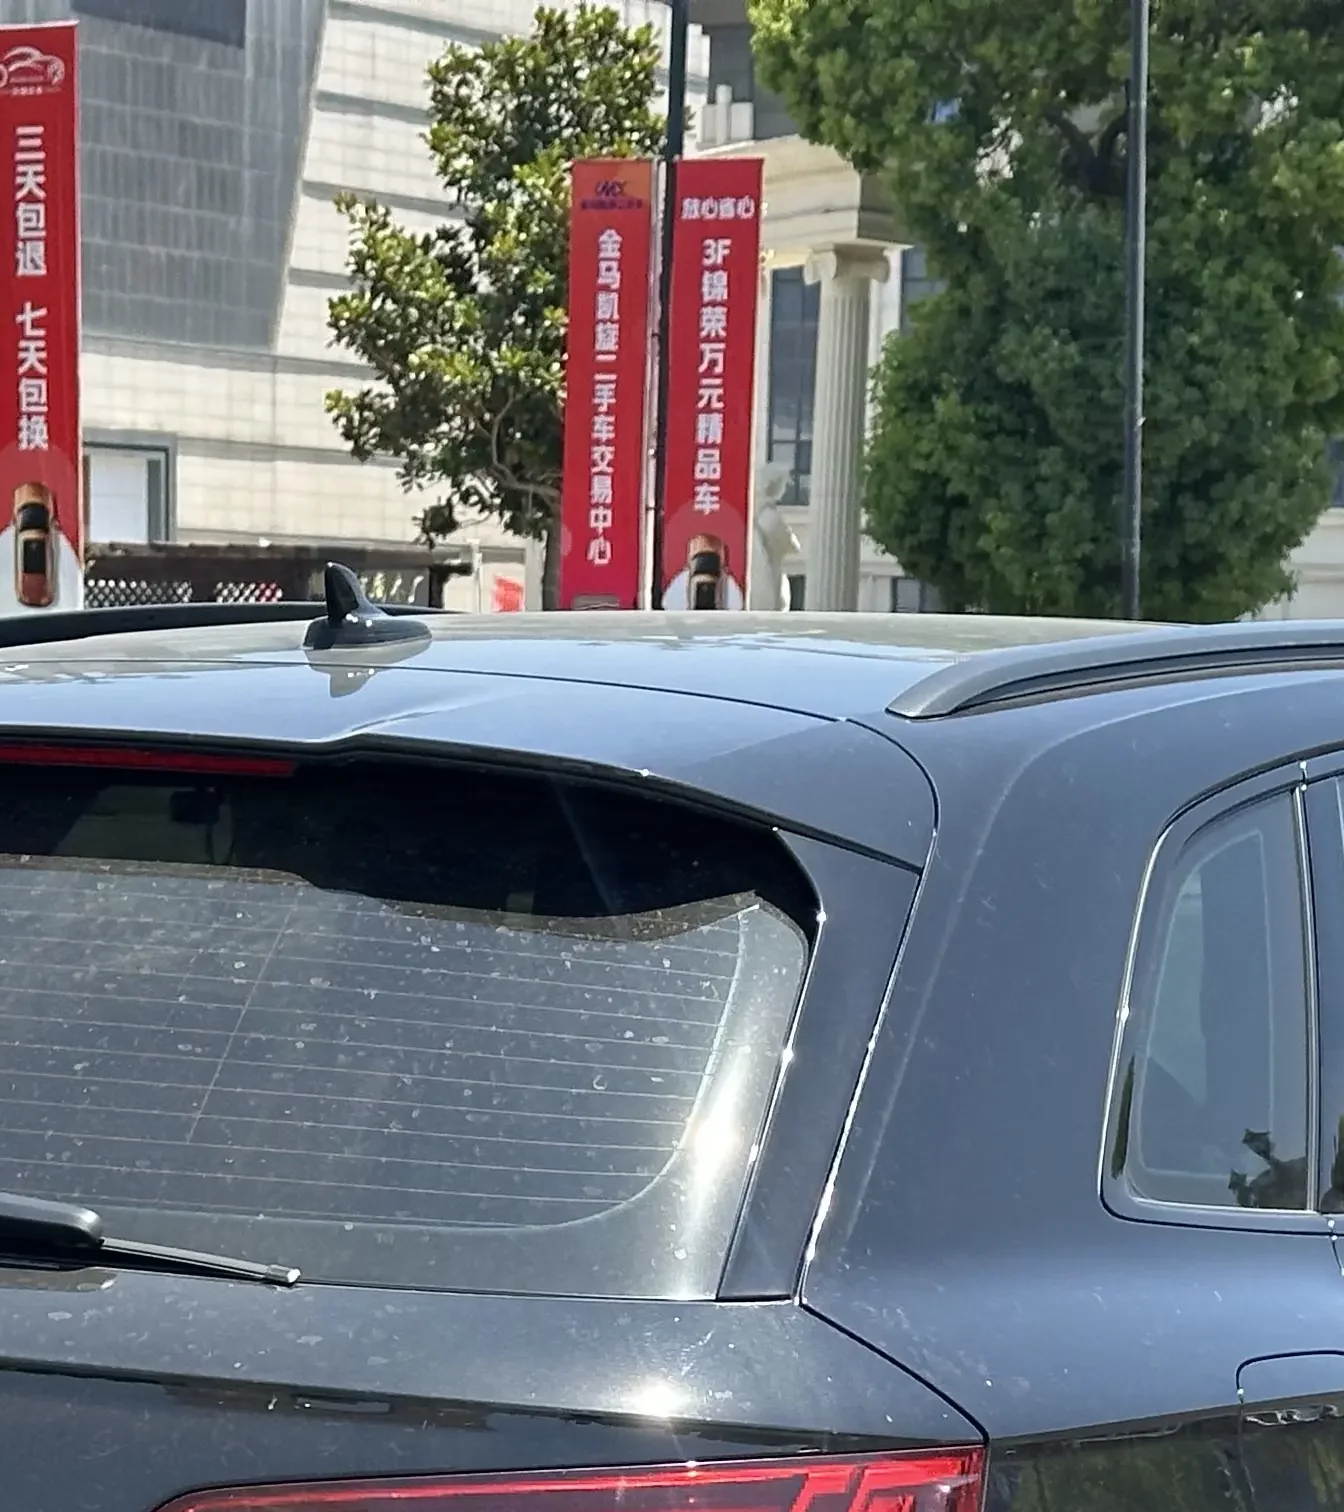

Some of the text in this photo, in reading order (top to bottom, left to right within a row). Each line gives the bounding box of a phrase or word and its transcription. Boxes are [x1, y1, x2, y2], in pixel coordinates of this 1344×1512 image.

[14, 125, 47, 277] 三天包退
[15, 301, 49, 451] 七天包换
